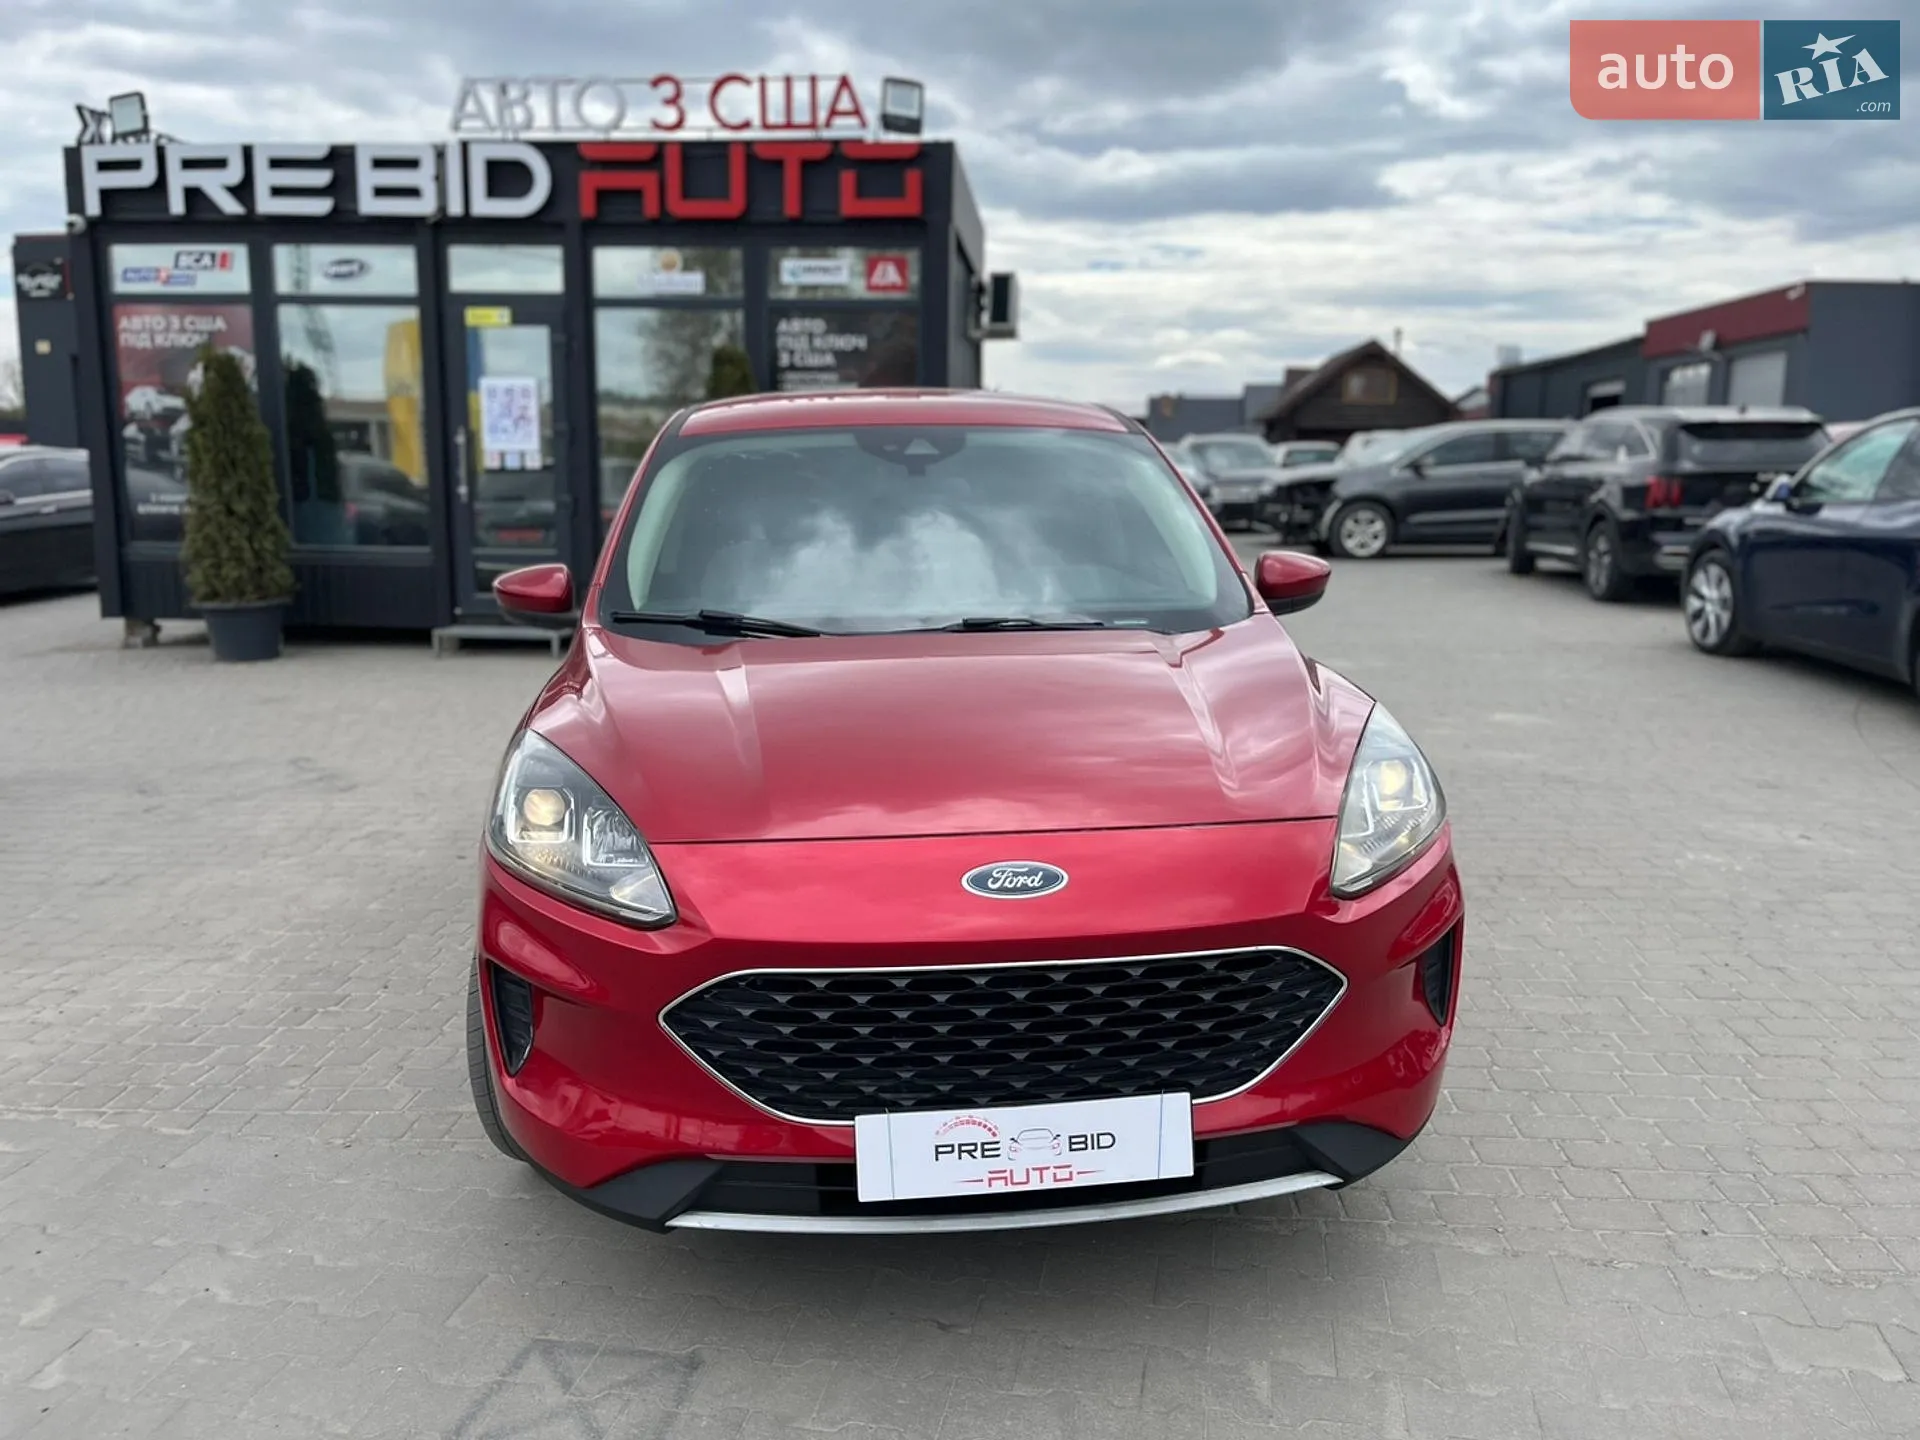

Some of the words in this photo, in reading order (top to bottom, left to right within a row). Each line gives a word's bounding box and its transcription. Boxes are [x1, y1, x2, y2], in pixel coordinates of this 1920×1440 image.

[450, 75, 629, 134] АВТО
[708, 73, 868, 131] США
[578, 142, 923, 219] AUTO
[118, 315, 167, 331] АВТО
[183, 315, 228, 332] США
[775, 317, 828, 334] АВТО
[792, 351, 837, 368] США
[987, 866, 1044, 890] Ford
[934, 1140, 1001, 1162] PRE
[1068, 1132, 1116, 1153] BID
[988, 1164, 1073, 1188] AUTO
